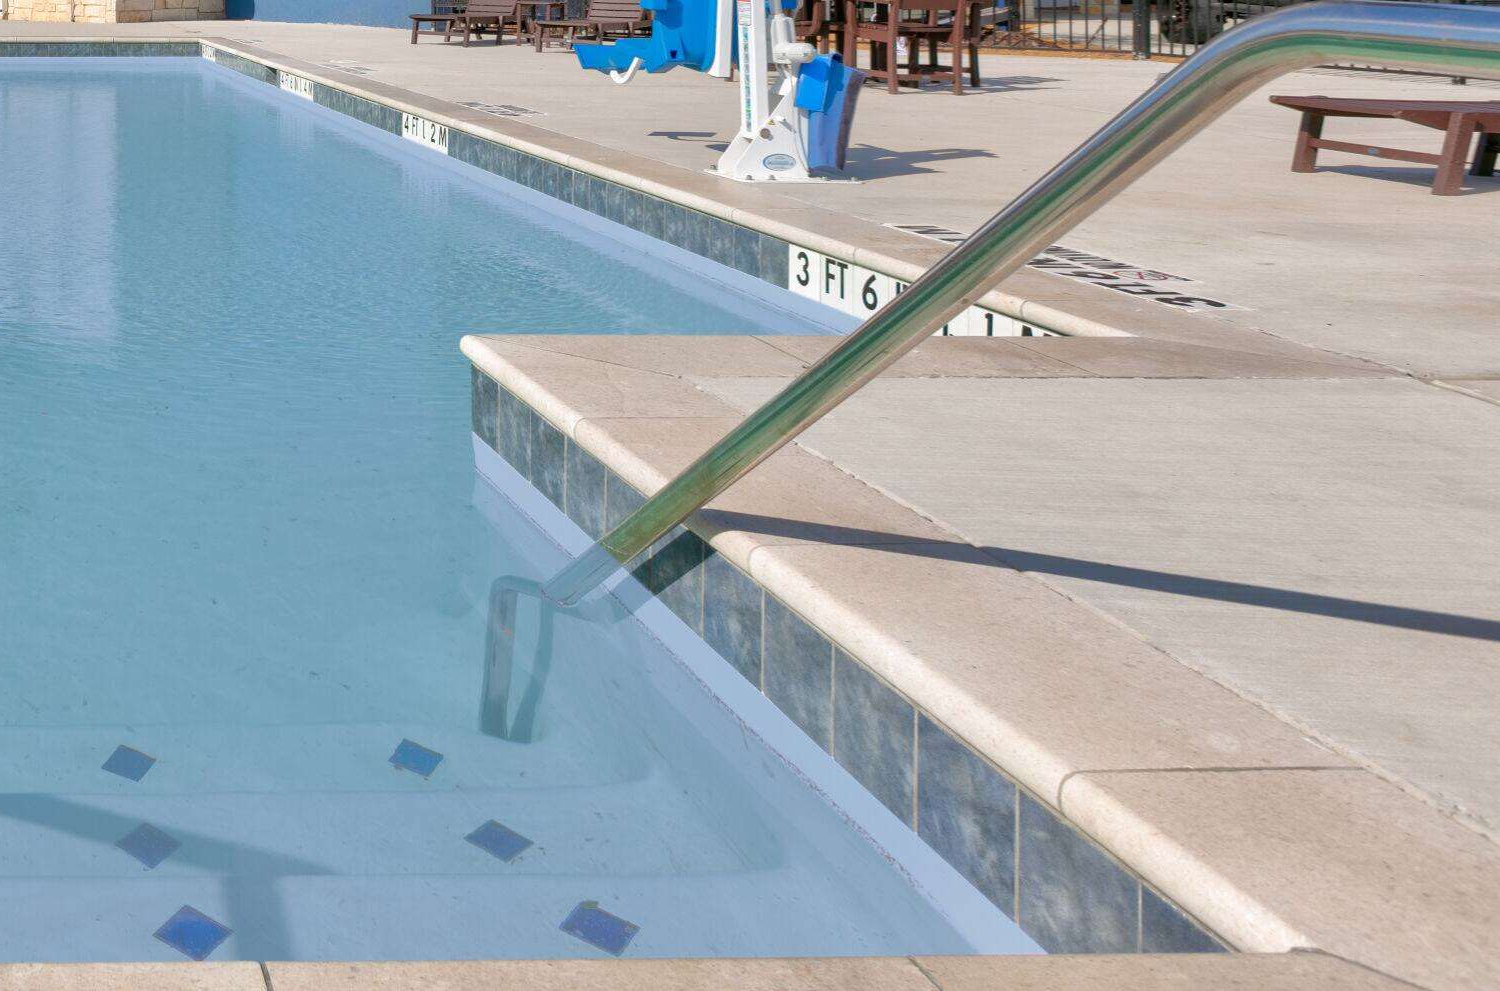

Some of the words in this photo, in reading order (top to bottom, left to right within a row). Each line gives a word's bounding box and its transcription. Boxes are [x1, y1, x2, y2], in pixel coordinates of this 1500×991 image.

[404, 114, 409, 133] 4
[411, 116, 419, 137] FT
[438, 125, 447, 147] M
[796, 251, 810, 287] 3
[825, 257, 849, 300] FT
[862, 274, 878, 311] 6
[1090, 281, 1184, 296] FT
[1155, 296, 1227, 308] 3
